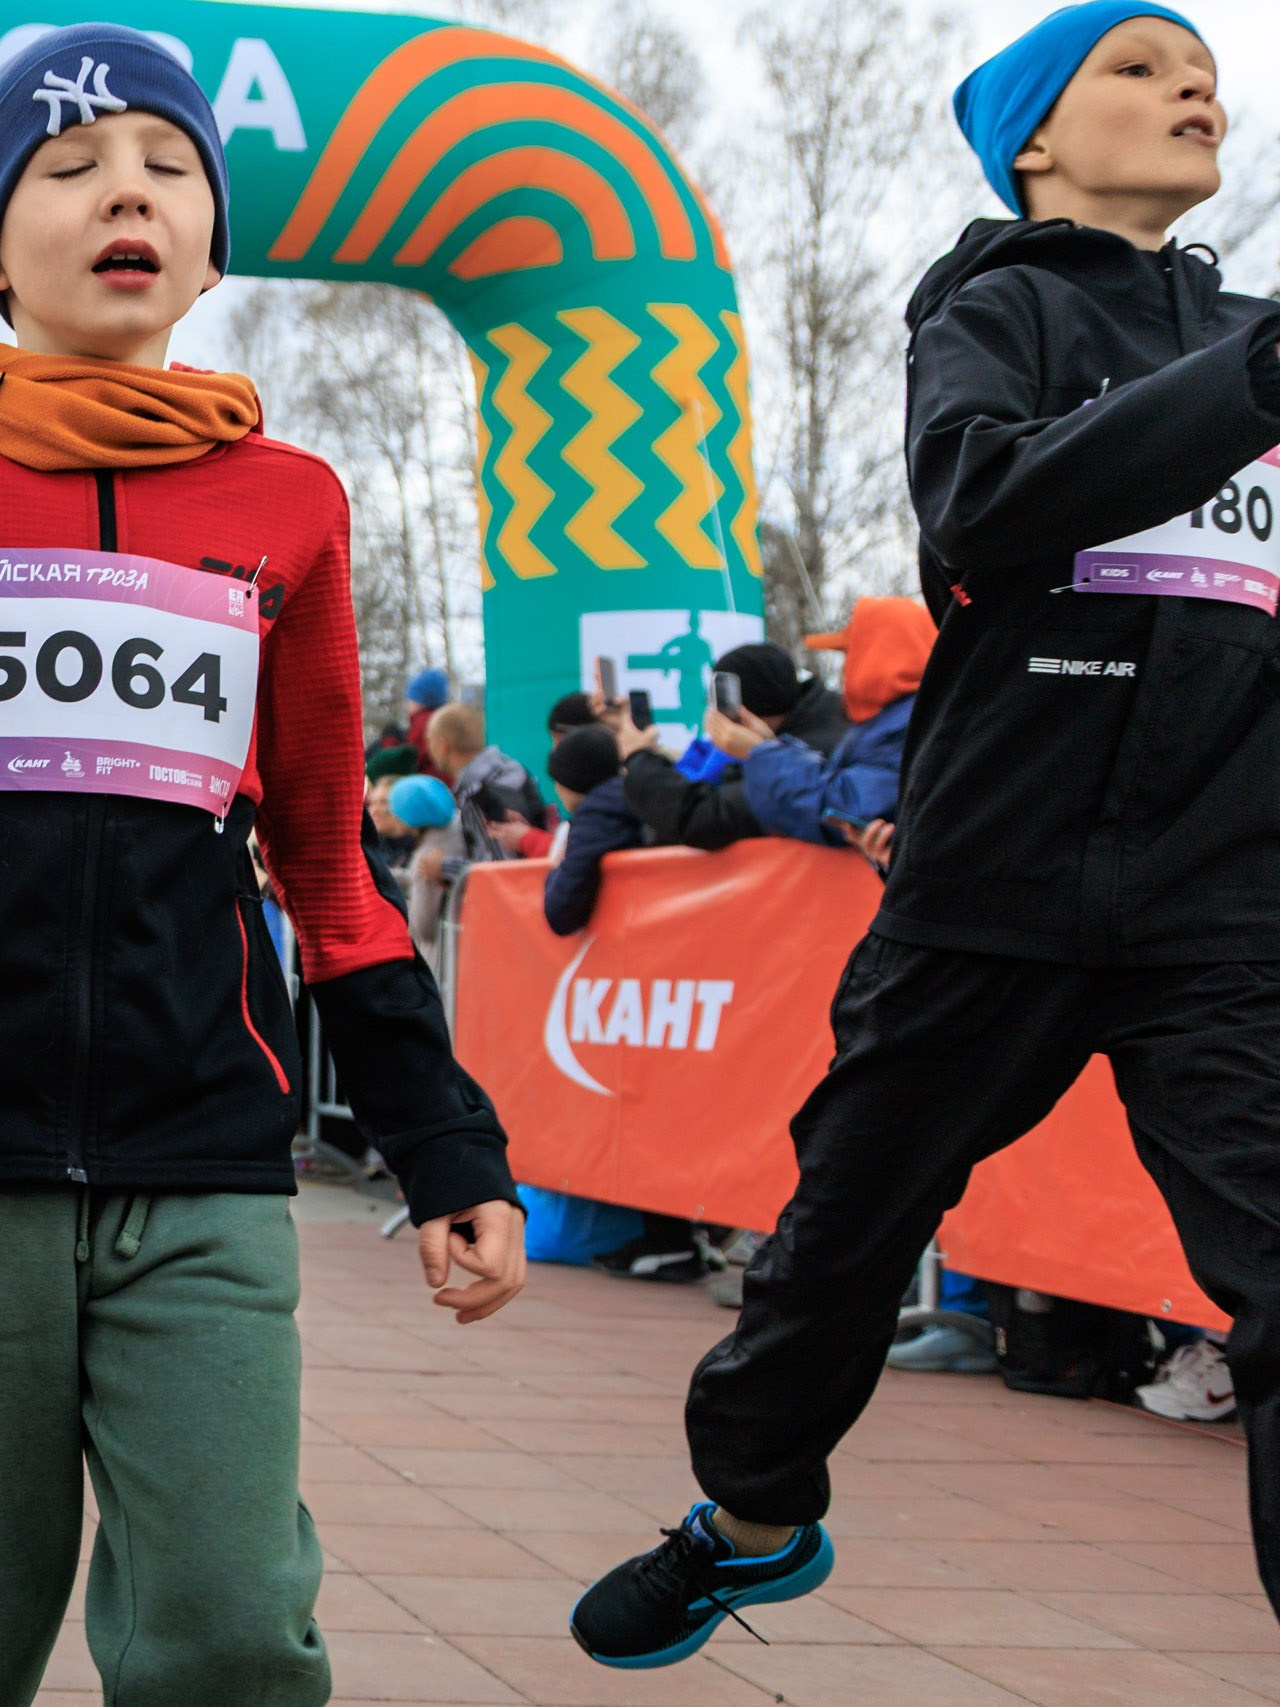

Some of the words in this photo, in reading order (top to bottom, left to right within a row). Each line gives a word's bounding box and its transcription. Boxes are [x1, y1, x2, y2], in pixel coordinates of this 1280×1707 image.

[86, 567, 150, 592] ГРОЗА
[1100, 568, 1130, 578] KIDS
[1061, 659, 1104, 675] NIKE
[1102, 661, 1137, 677] AIR
[14, 758, 51, 769] КАНТ
[95, 766, 113, 776] FIT
[571, 977, 735, 1052] КАНТ
